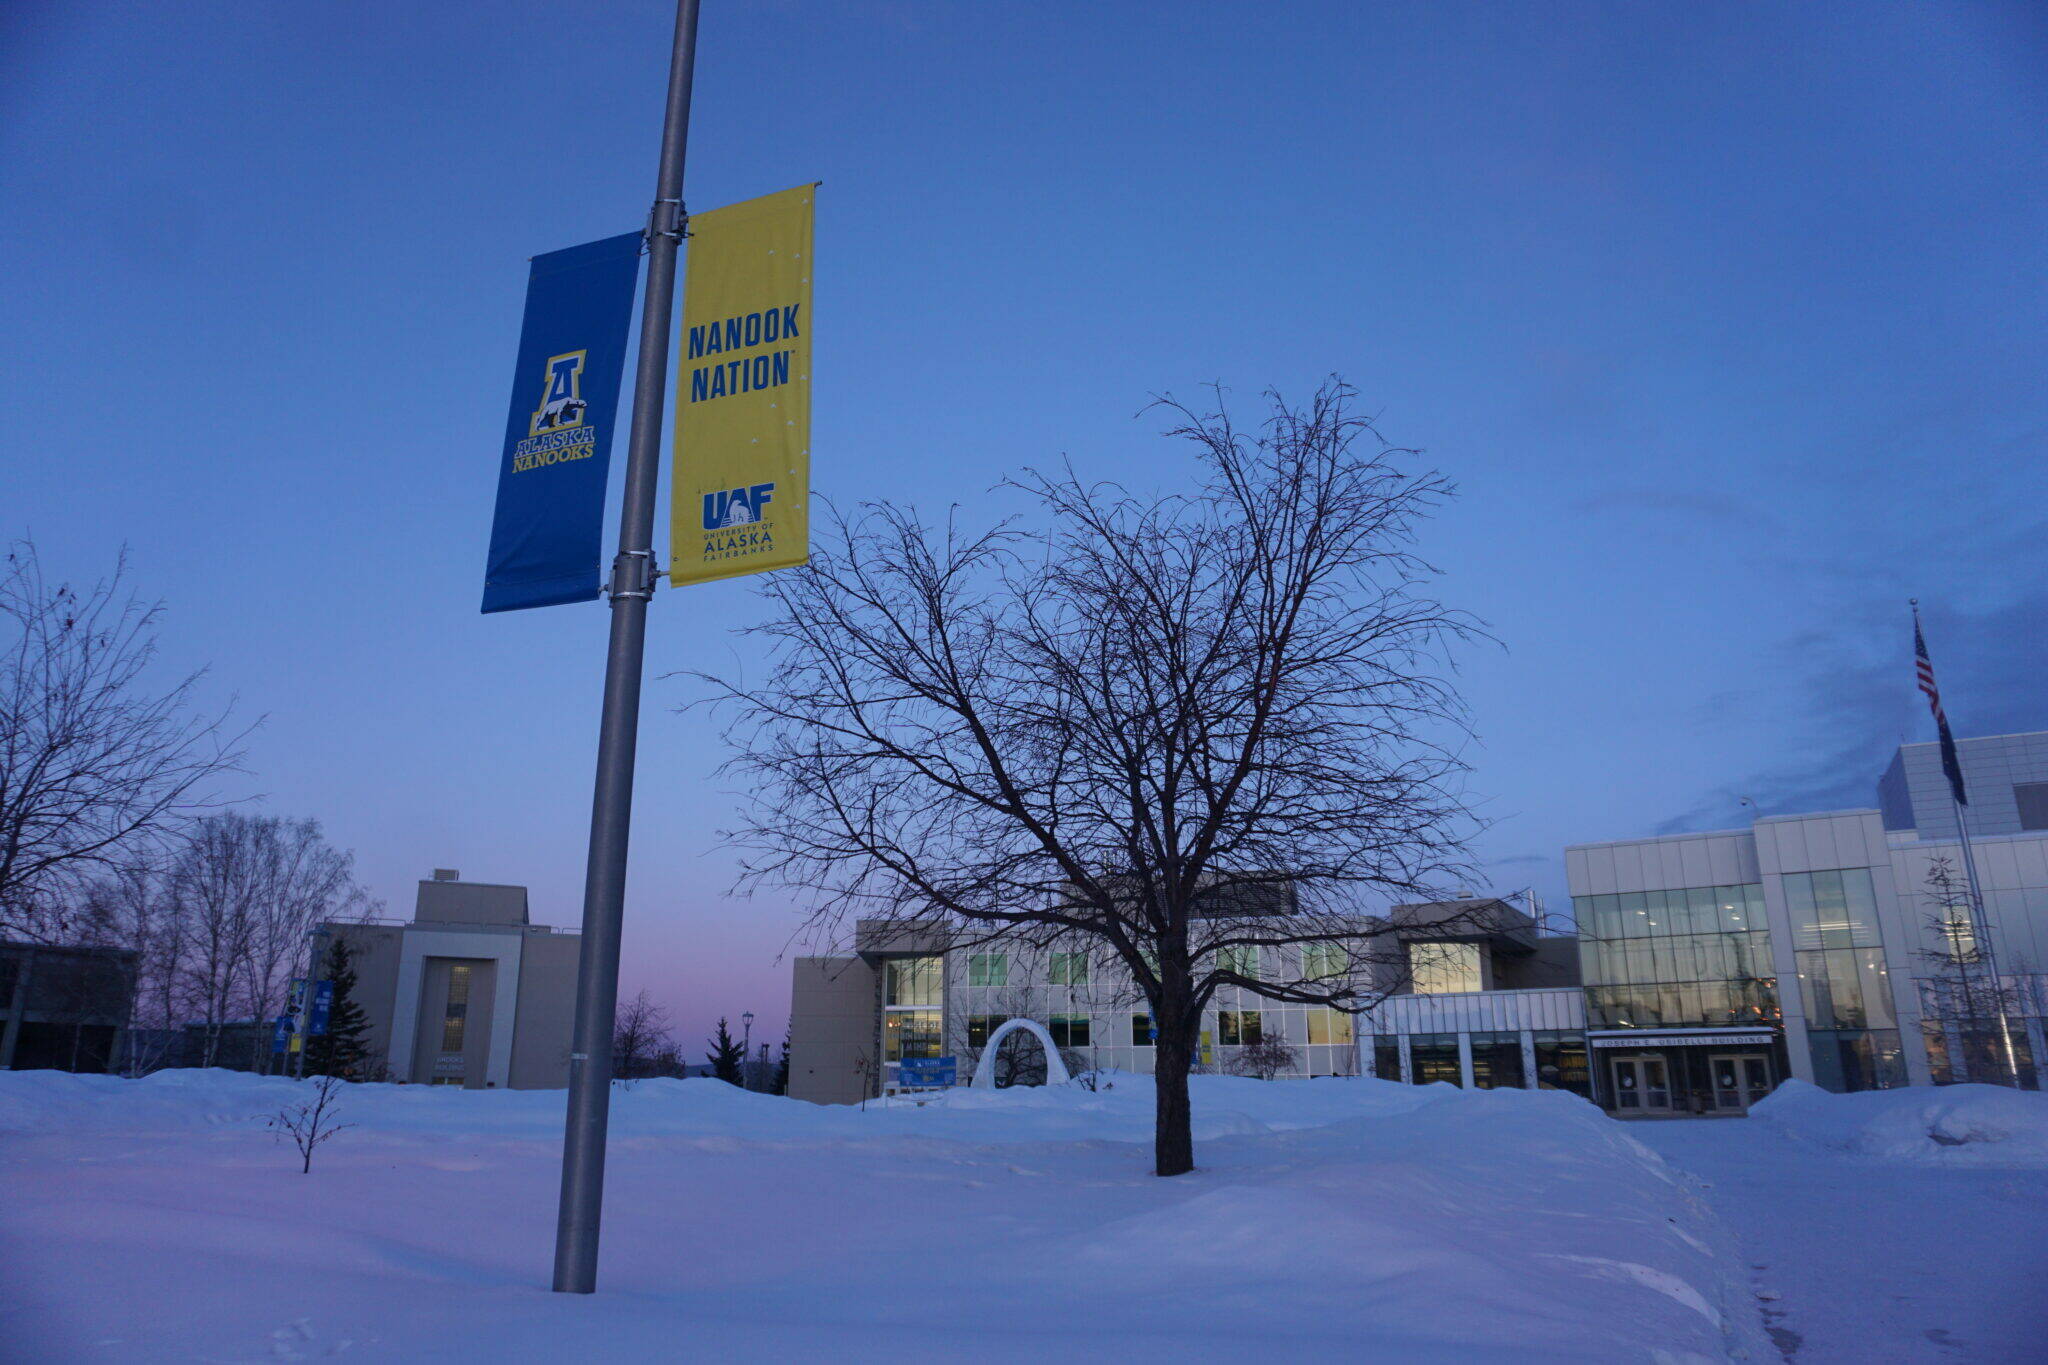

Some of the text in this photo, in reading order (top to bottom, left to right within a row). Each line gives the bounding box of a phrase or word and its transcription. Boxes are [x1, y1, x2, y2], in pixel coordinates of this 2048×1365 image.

[688, 303, 800, 360] NANOOK
[529, 349, 587, 437] A
[691, 350, 789, 403] NATION
[512, 443, 594, 473] NANOOKS
[514, 425, 595, 459] ALASKA
[703, 482, 775, 530] UAF
[704, 522, 774, 540] UNIVERSITY OF
[704, 531, 772, 553] ALASKA
[703, 544, 775, 562] FAIRBANKS
